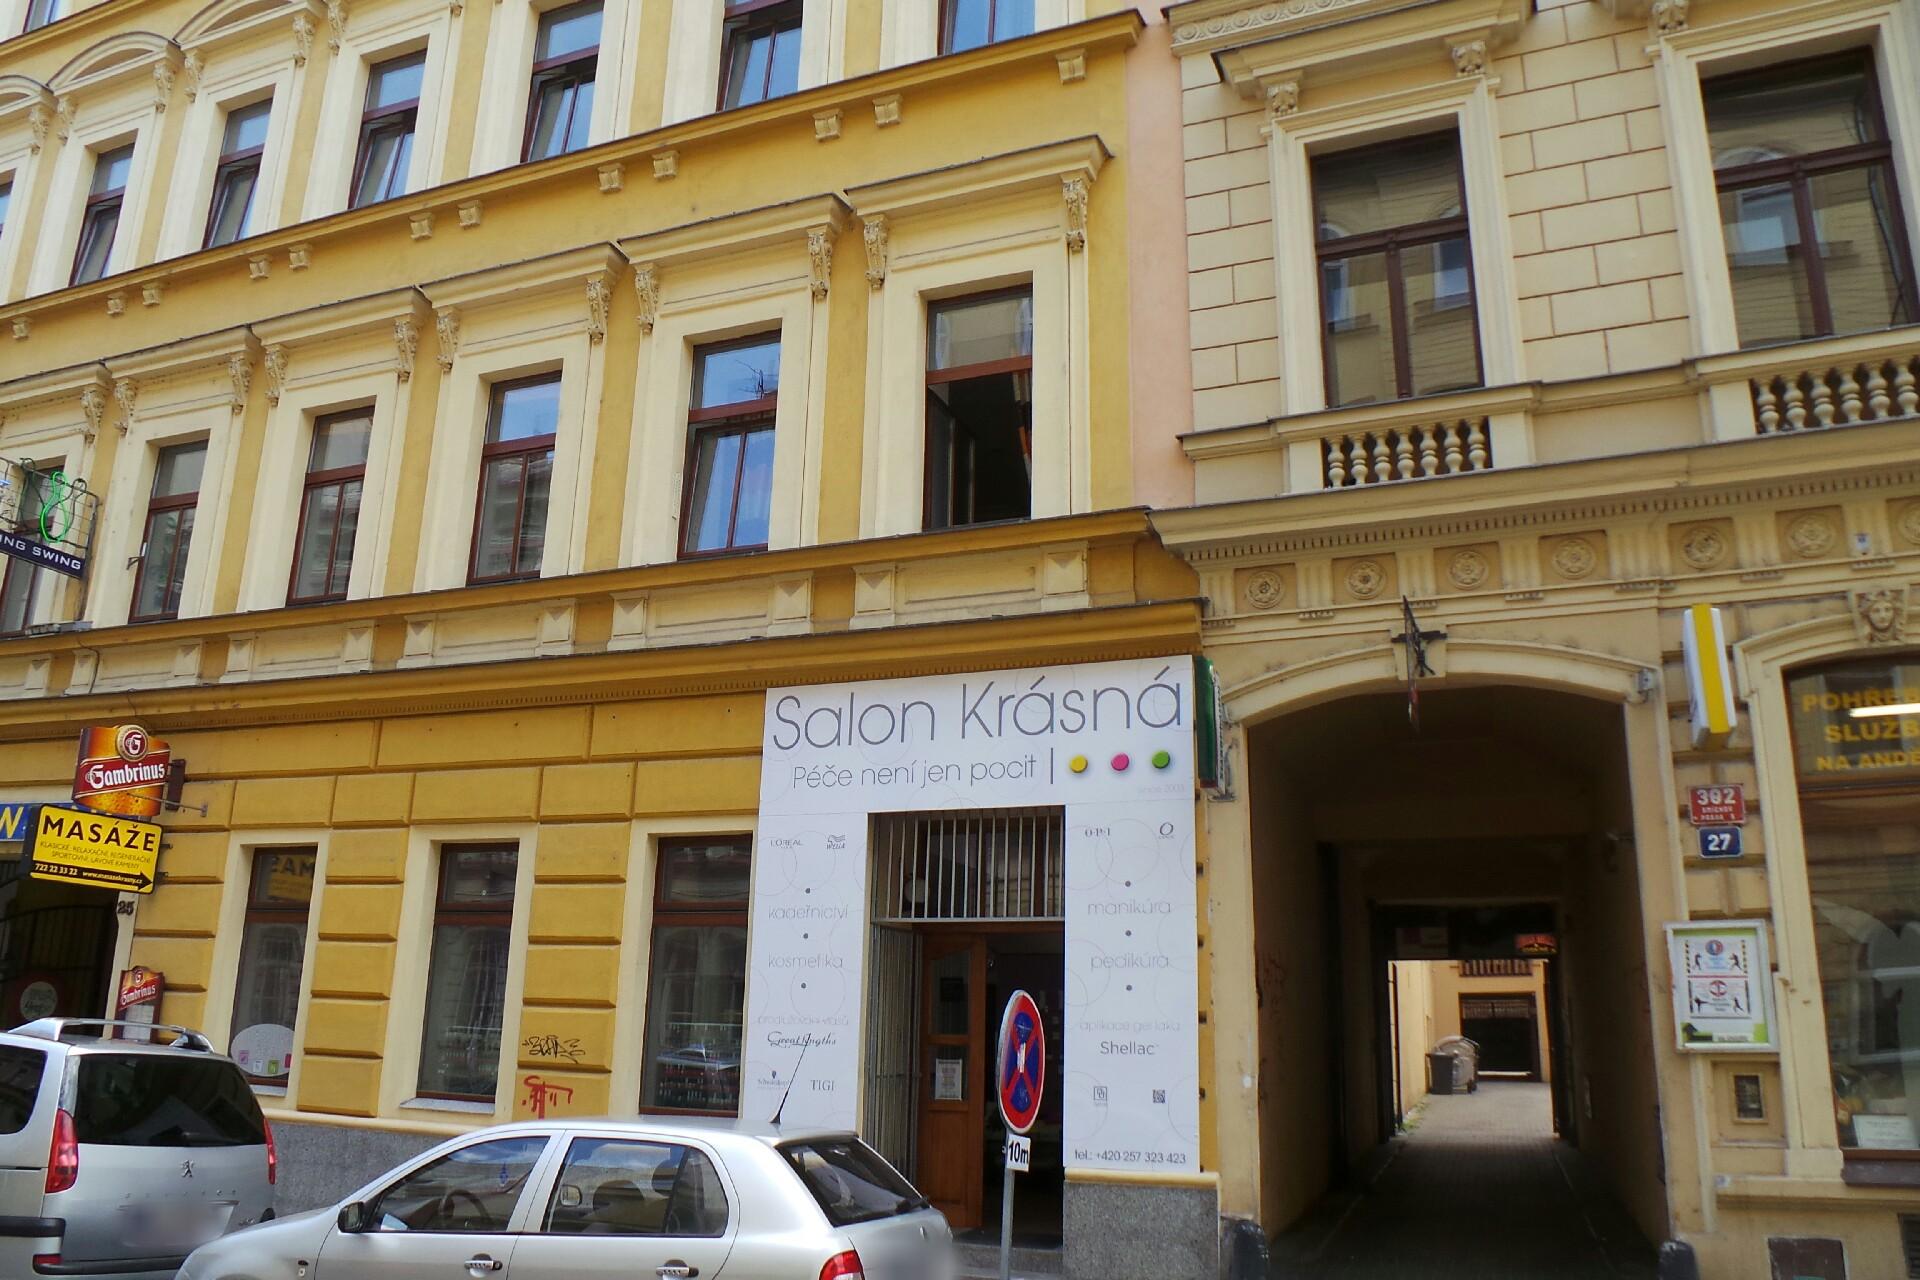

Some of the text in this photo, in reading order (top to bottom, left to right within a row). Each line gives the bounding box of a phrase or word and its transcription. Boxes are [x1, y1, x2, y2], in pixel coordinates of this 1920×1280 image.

[32, 546, 81, 570] SWING
[773, 691, 936, 750] Salon
[961, 665, 1182, 739] Krásná
[792, 754, 1037, 790] Péče není jen pocit
[1816, 755, 1851, 771] NA
[88, 763, 165, 789] Gambrinus
[43, 815, 156, 852] MASÁŽE
[1707, 833, 1732, 851] 27
[117, 900, 135, 915] 25
[768, 903, 848, 920] kadeřnictví
[768, 952, 843, 969] kosmetika
[121, 983, 156, 1005] Gambrinus
[1100, 1041, 1155, 1056] Shellac
[810, 1079, 835, 1092] TIGI
[1009, 1141, 1029, 1165] 10m
